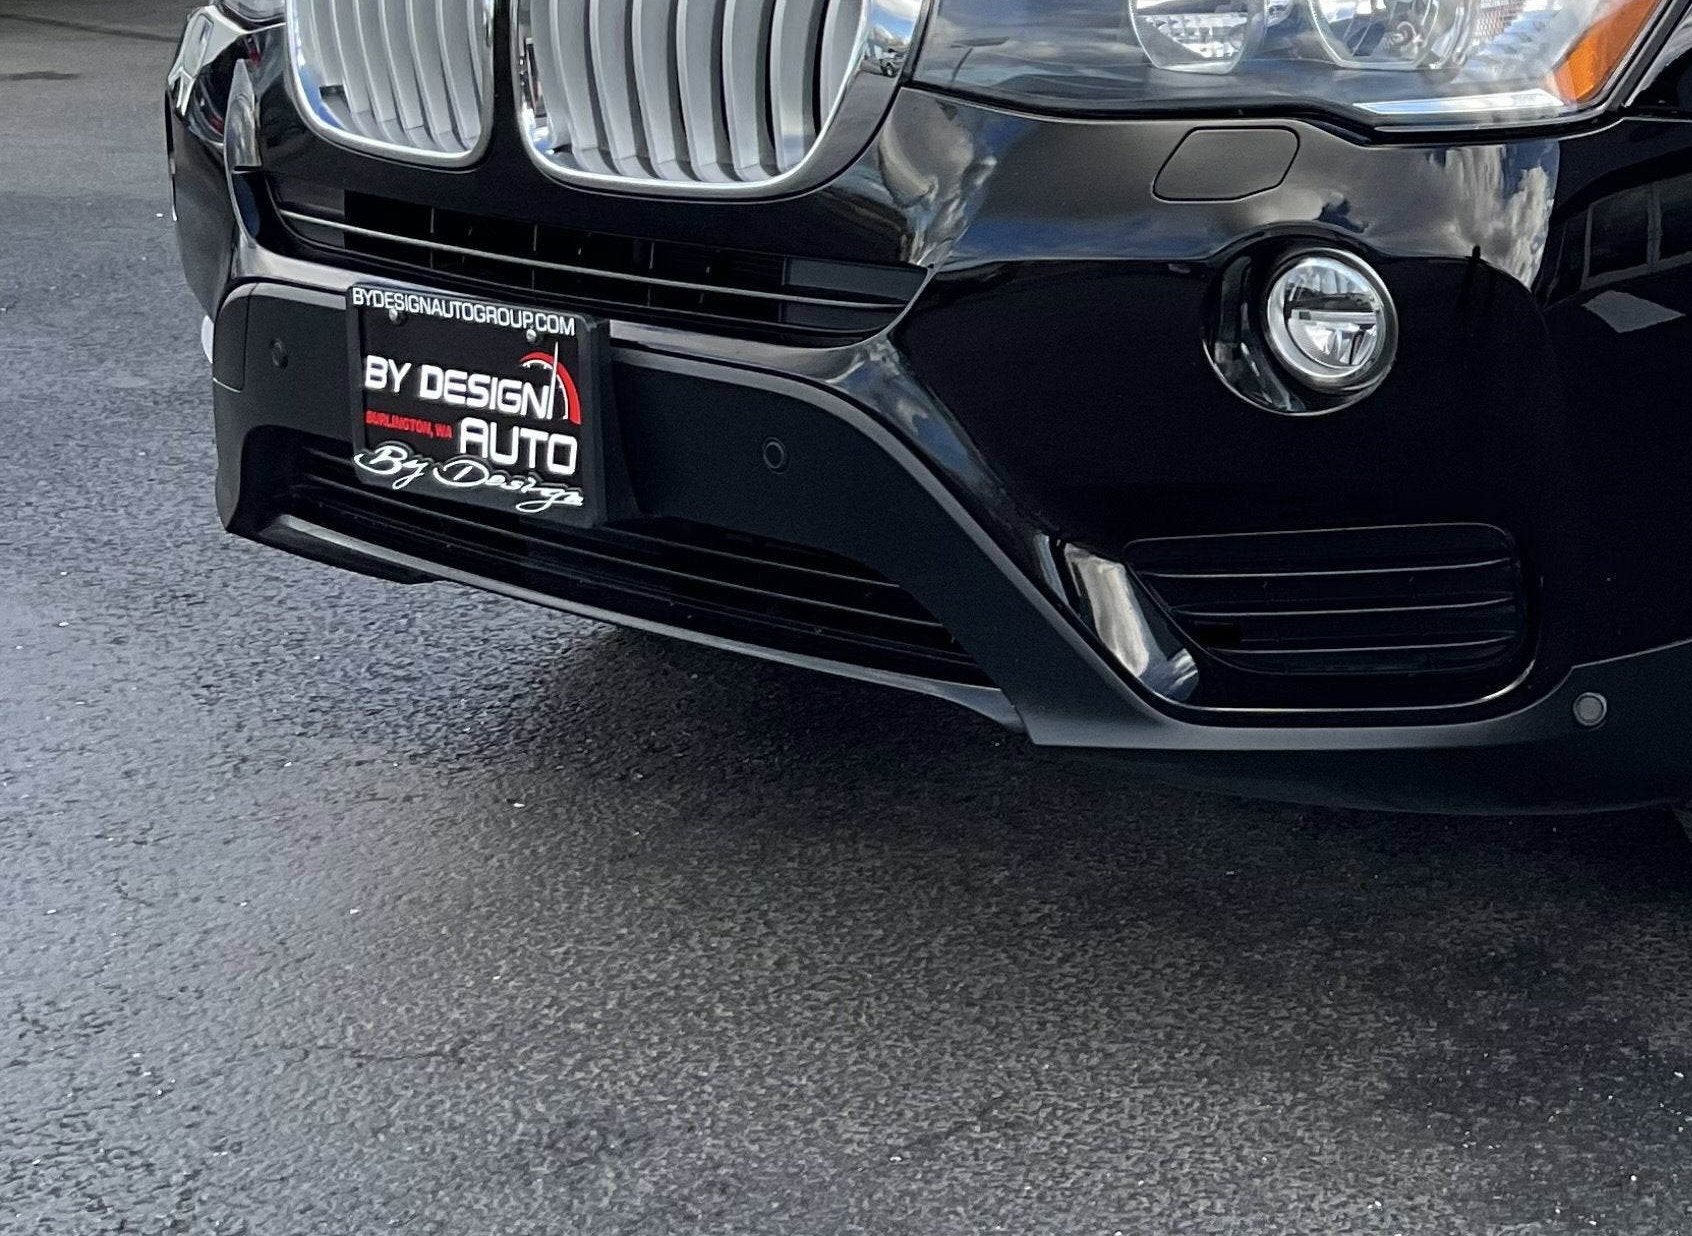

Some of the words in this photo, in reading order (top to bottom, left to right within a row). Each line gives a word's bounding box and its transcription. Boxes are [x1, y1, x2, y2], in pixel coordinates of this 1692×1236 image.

[353, 288, 575, 337] BYDESIGNAUTOGROUP.COM
[364, 354, 411, 393] BY
[419, 365, 549, 420] DESIGN
[435, 422, 453, 439] WA
[460, 417, 578, 476] AUTO
[353, 445, 428, 490] By
[432, 459, 584, 514] Design
